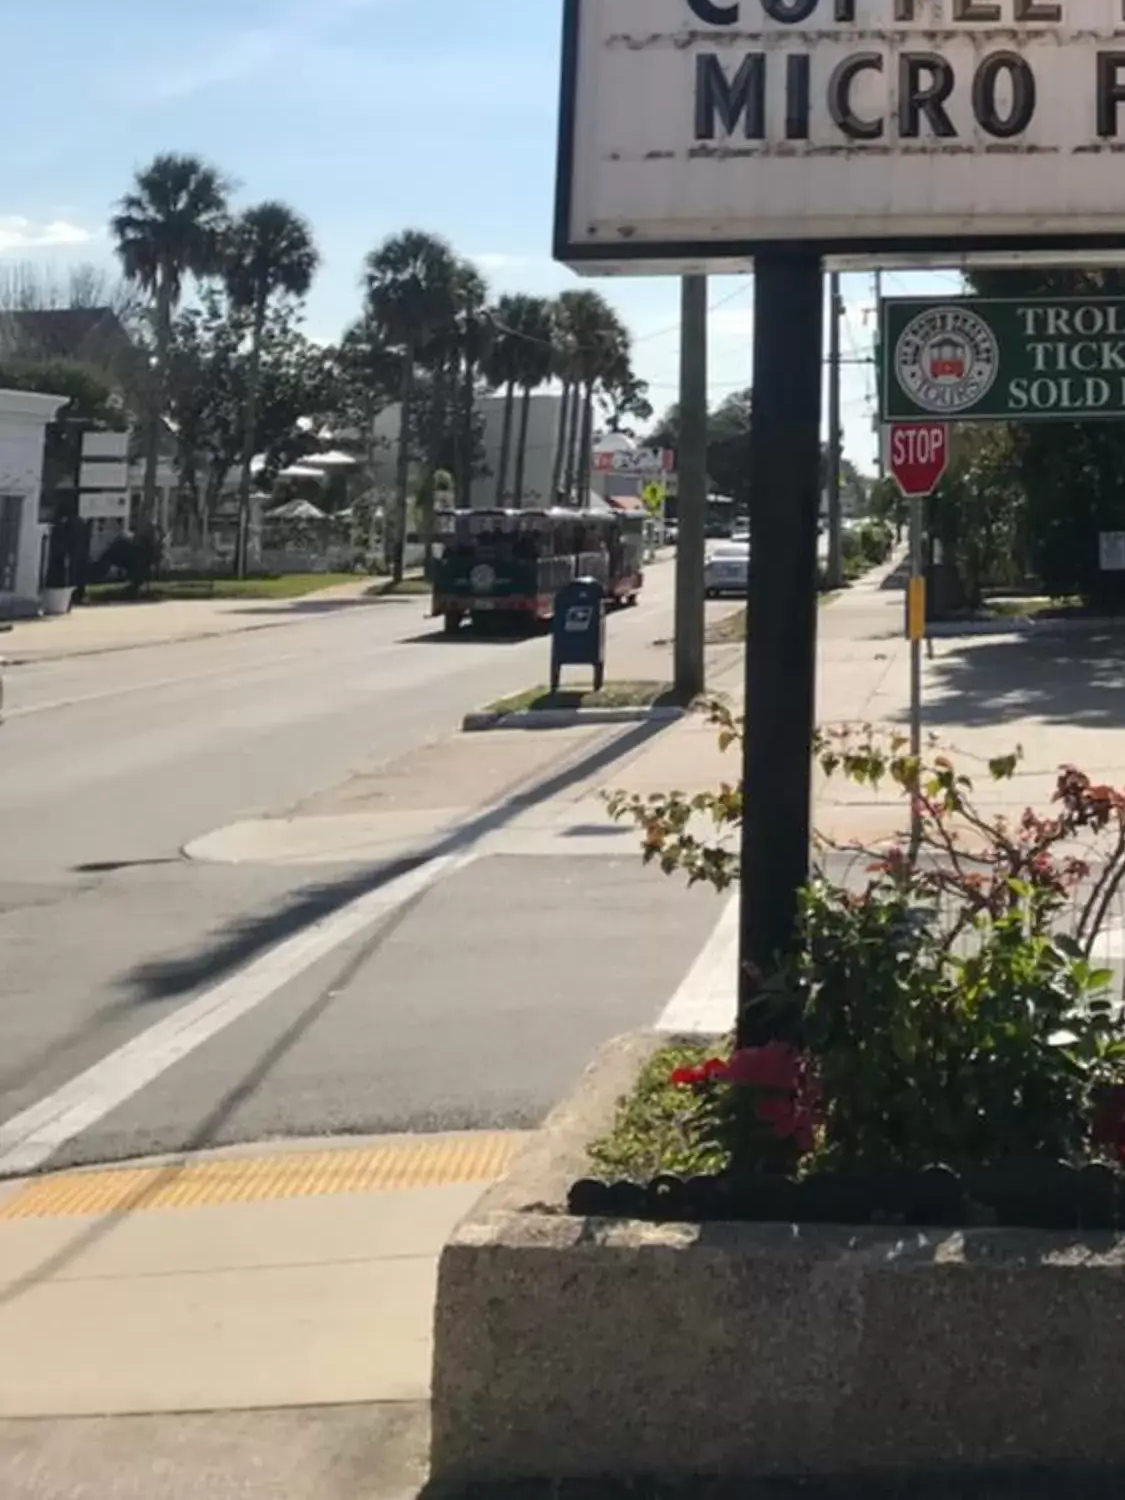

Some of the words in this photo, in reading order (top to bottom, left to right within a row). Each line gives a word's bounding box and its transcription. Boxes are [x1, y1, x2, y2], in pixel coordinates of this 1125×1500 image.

[694, 50, 1037, 141] MICRO
[1008, 377, 1110, 408] SOLD
[893, 428, 943, 465] STOP
